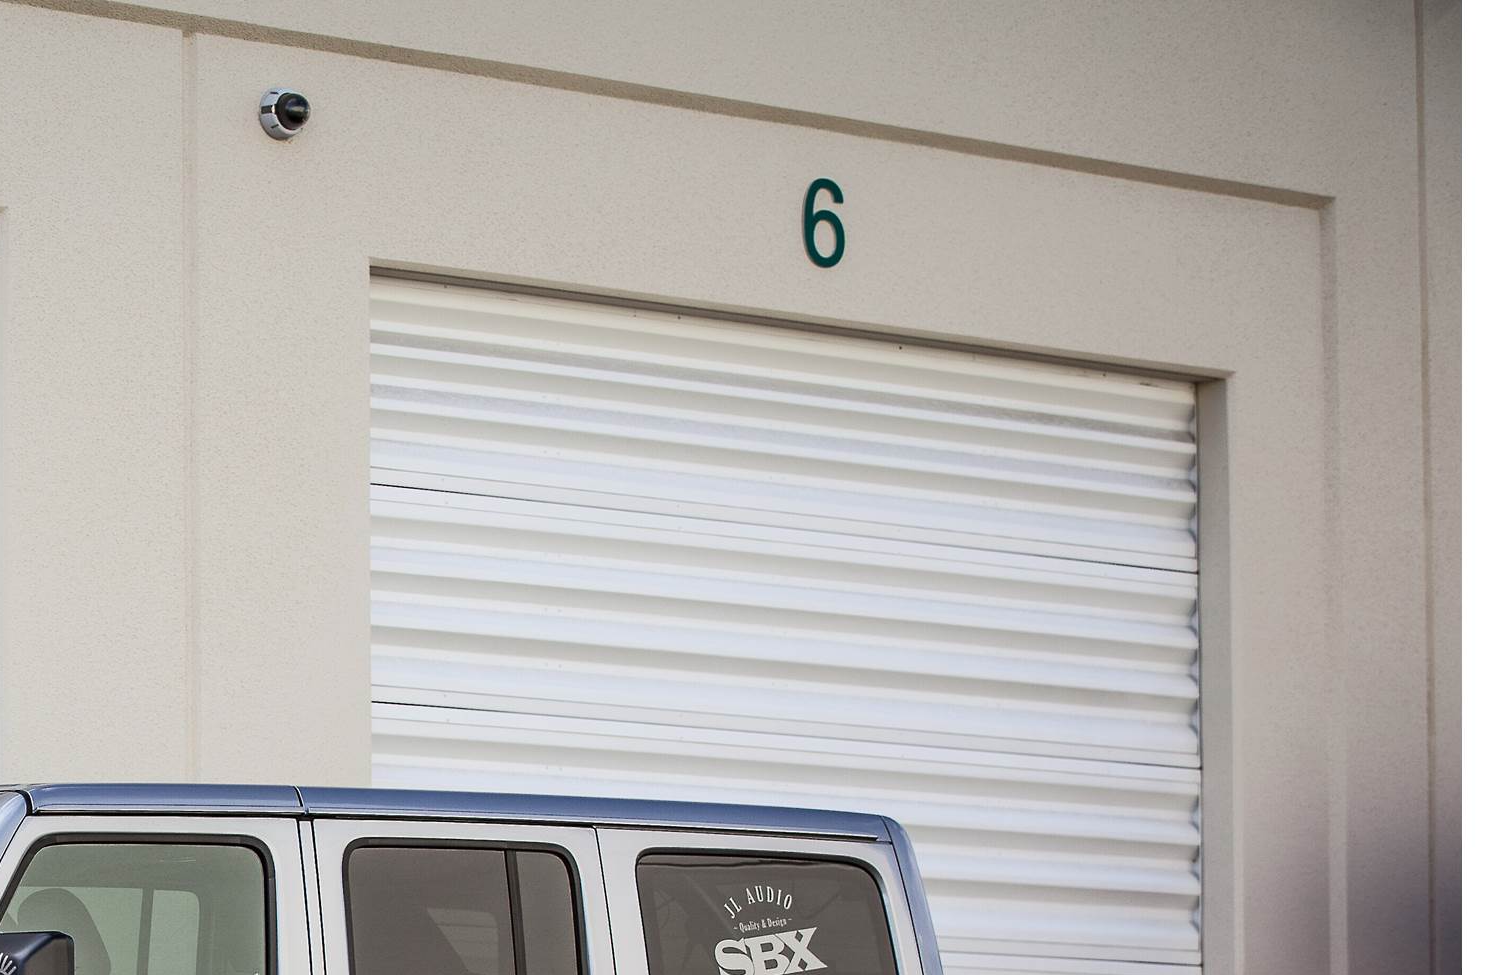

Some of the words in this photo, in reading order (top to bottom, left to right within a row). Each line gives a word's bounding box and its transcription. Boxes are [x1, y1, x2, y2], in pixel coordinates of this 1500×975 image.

[803, 177, 846, 269] 6
[724, 897, 742, 919] JL
[746, 885, 793, 910] AUDIO
[739, 921, 760, 933] Quality
[767, 917, 787, 928] Design
